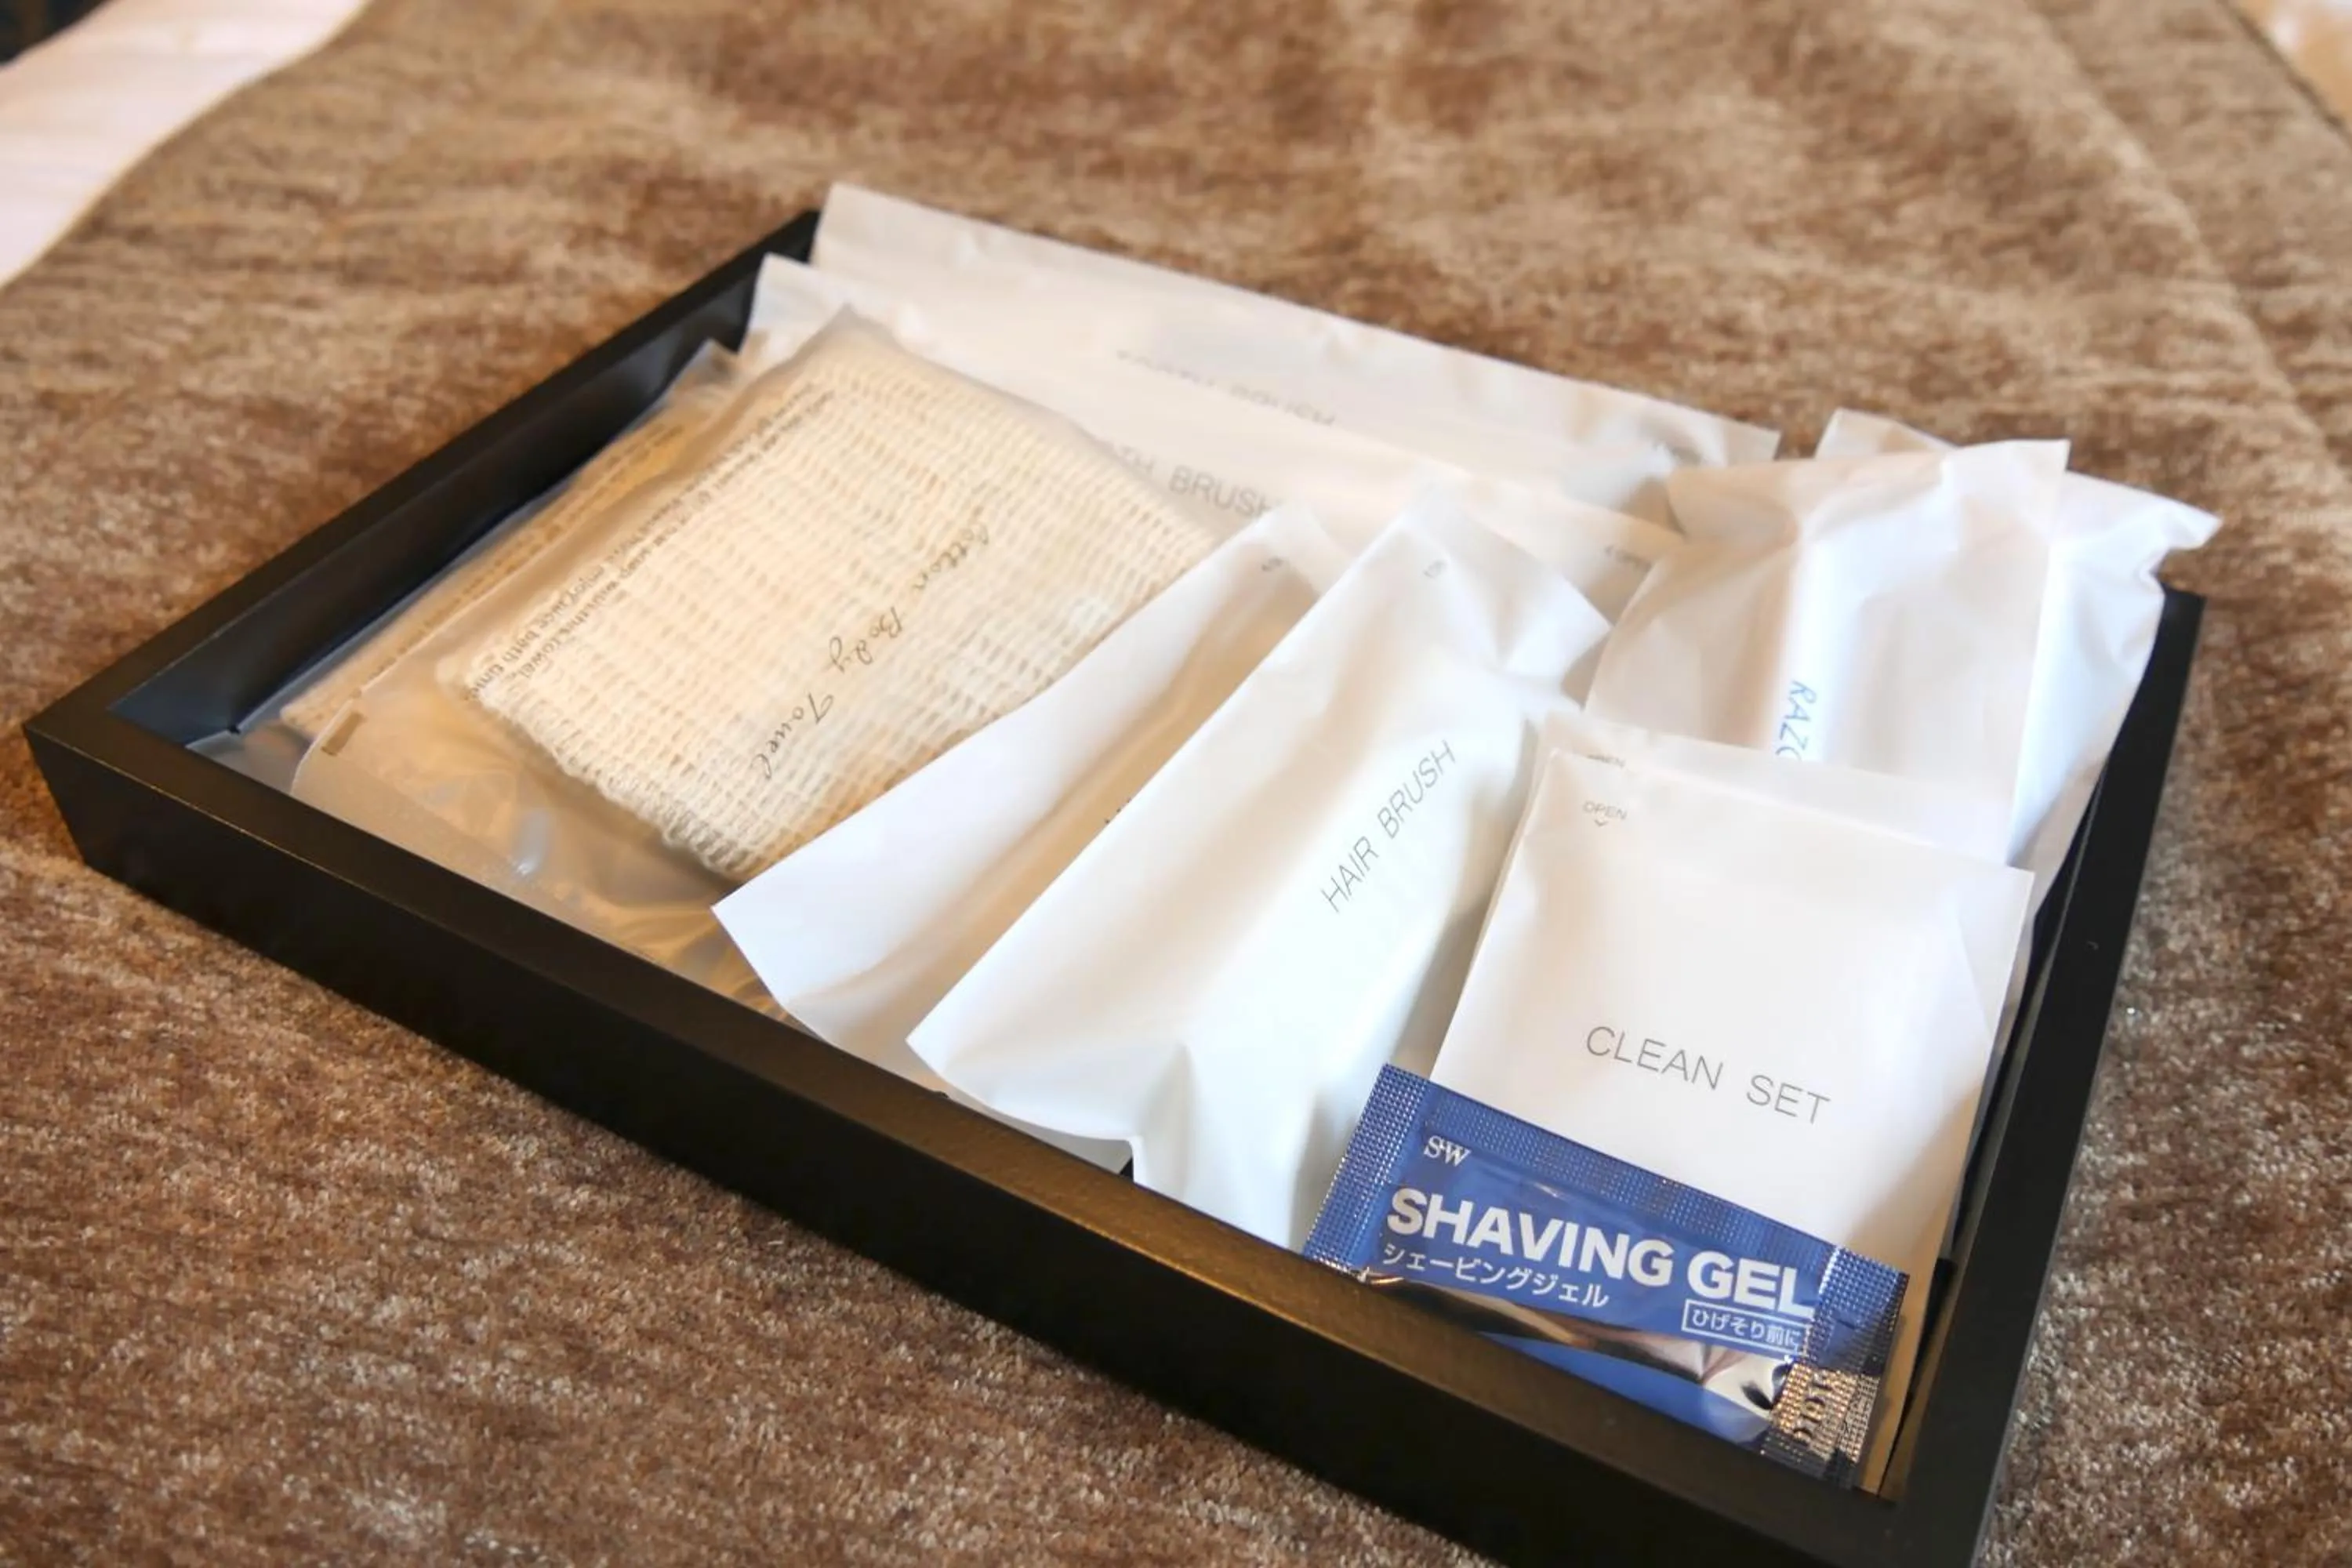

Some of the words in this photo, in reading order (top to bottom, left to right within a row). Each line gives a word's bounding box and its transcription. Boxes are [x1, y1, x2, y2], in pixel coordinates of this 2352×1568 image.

[827, 607, 902, 673] Body
[751, 693, 833, 779] Towel
[1320, 836, 1380, 913] HAIR
[1377, 739, 1457, 839] BRUSH
[1583, 800, 1628, 821] OPEN
[1586, 1025, 1723, 1091] CLEAN
[1746, 1074, 1831, 1124] SET
[1382, 1243, 1610, 1309] シェービングジェル
[1387, 1188, 1672, 1289] SHAVING
[1687, 1250, 1816, 1319] GEL
[1692, 1308, 1802, 1348] ひげそり前に
